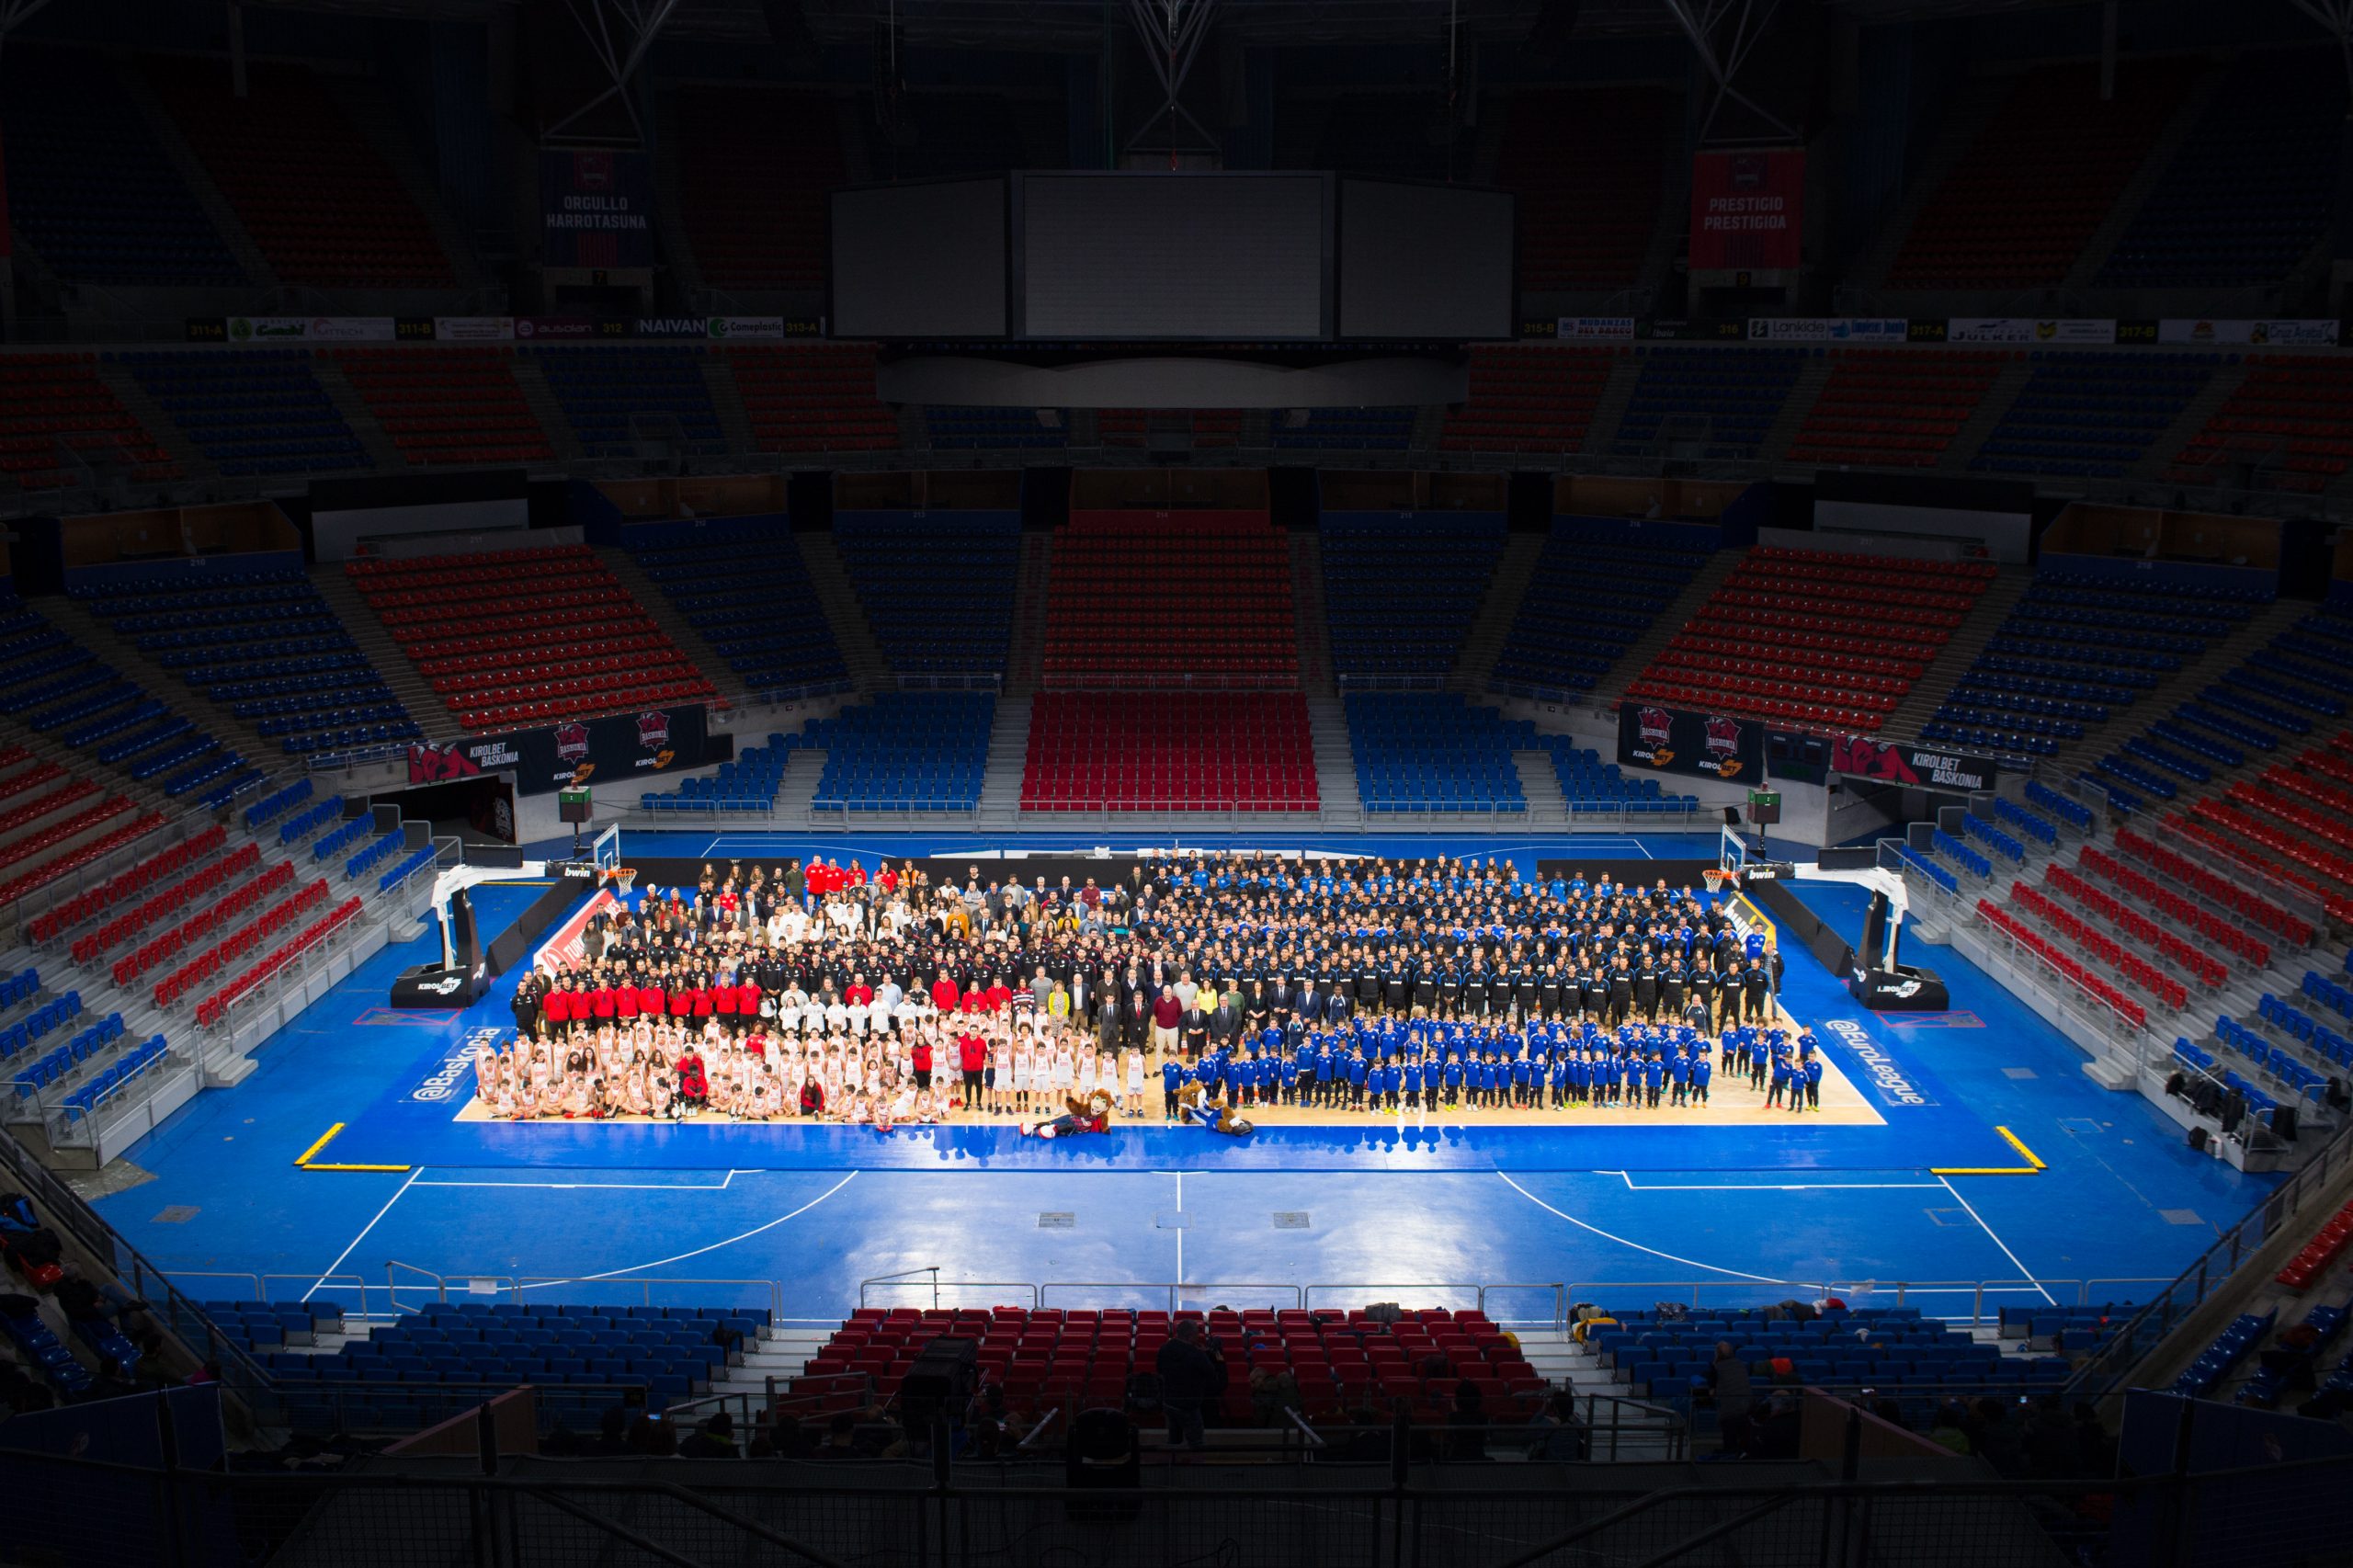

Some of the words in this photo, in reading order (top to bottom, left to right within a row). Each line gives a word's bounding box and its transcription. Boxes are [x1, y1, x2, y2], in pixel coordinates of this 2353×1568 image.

[564, 196, 628, 210] ORGULLO
[1709, 197, 1783, 212] PRESTIGIO
[546, 213, 647, 229] HARROTASUNA
[1704, 215, 1786, 231] PRESTIGIOA
[190, 324, 223, 336] 311-A
[398, 323, 431, 335] 311-B
[538, 324, 592, 333] ausolan
[602, 324, 623, 334] 312
[640, 320, 705, 333] NAIVAN
[731, 322, 782, 335] Comeplastic
[786, 323, 817, 333] 313-A
[1524, 324, 1555, 334] 315-B
[1720, 324, 1738, 335] 316
[1773, 320, 1824, 333] Lankide
[1911, 324, 1944, 337] 317-A
[2119, 324, 2155, 337] 317-B
[1951, 332, 2029, 341] JULKER
[190, 558, 206, 567] 210
[642, 729, 667, 742] BASKONIA
[1641, 727, 1668, 739] BASKONIA
[560, 742, 587, 755] BASKONIA
[1708, 737, 1735, 750] BASKONIA
[470, 743, 506, 758] KIROLBET
[481, 751, 519, 767] BASKONIA
[1912, 752, 1961, 772] KIROLBET
[1932, 769, 1983, 790] BASKONIA
[564, 867, 590, 878] bwin
[1749, 869, 1775, 880] bwin
[413, 1028, 502, 1101] @Baskonia
